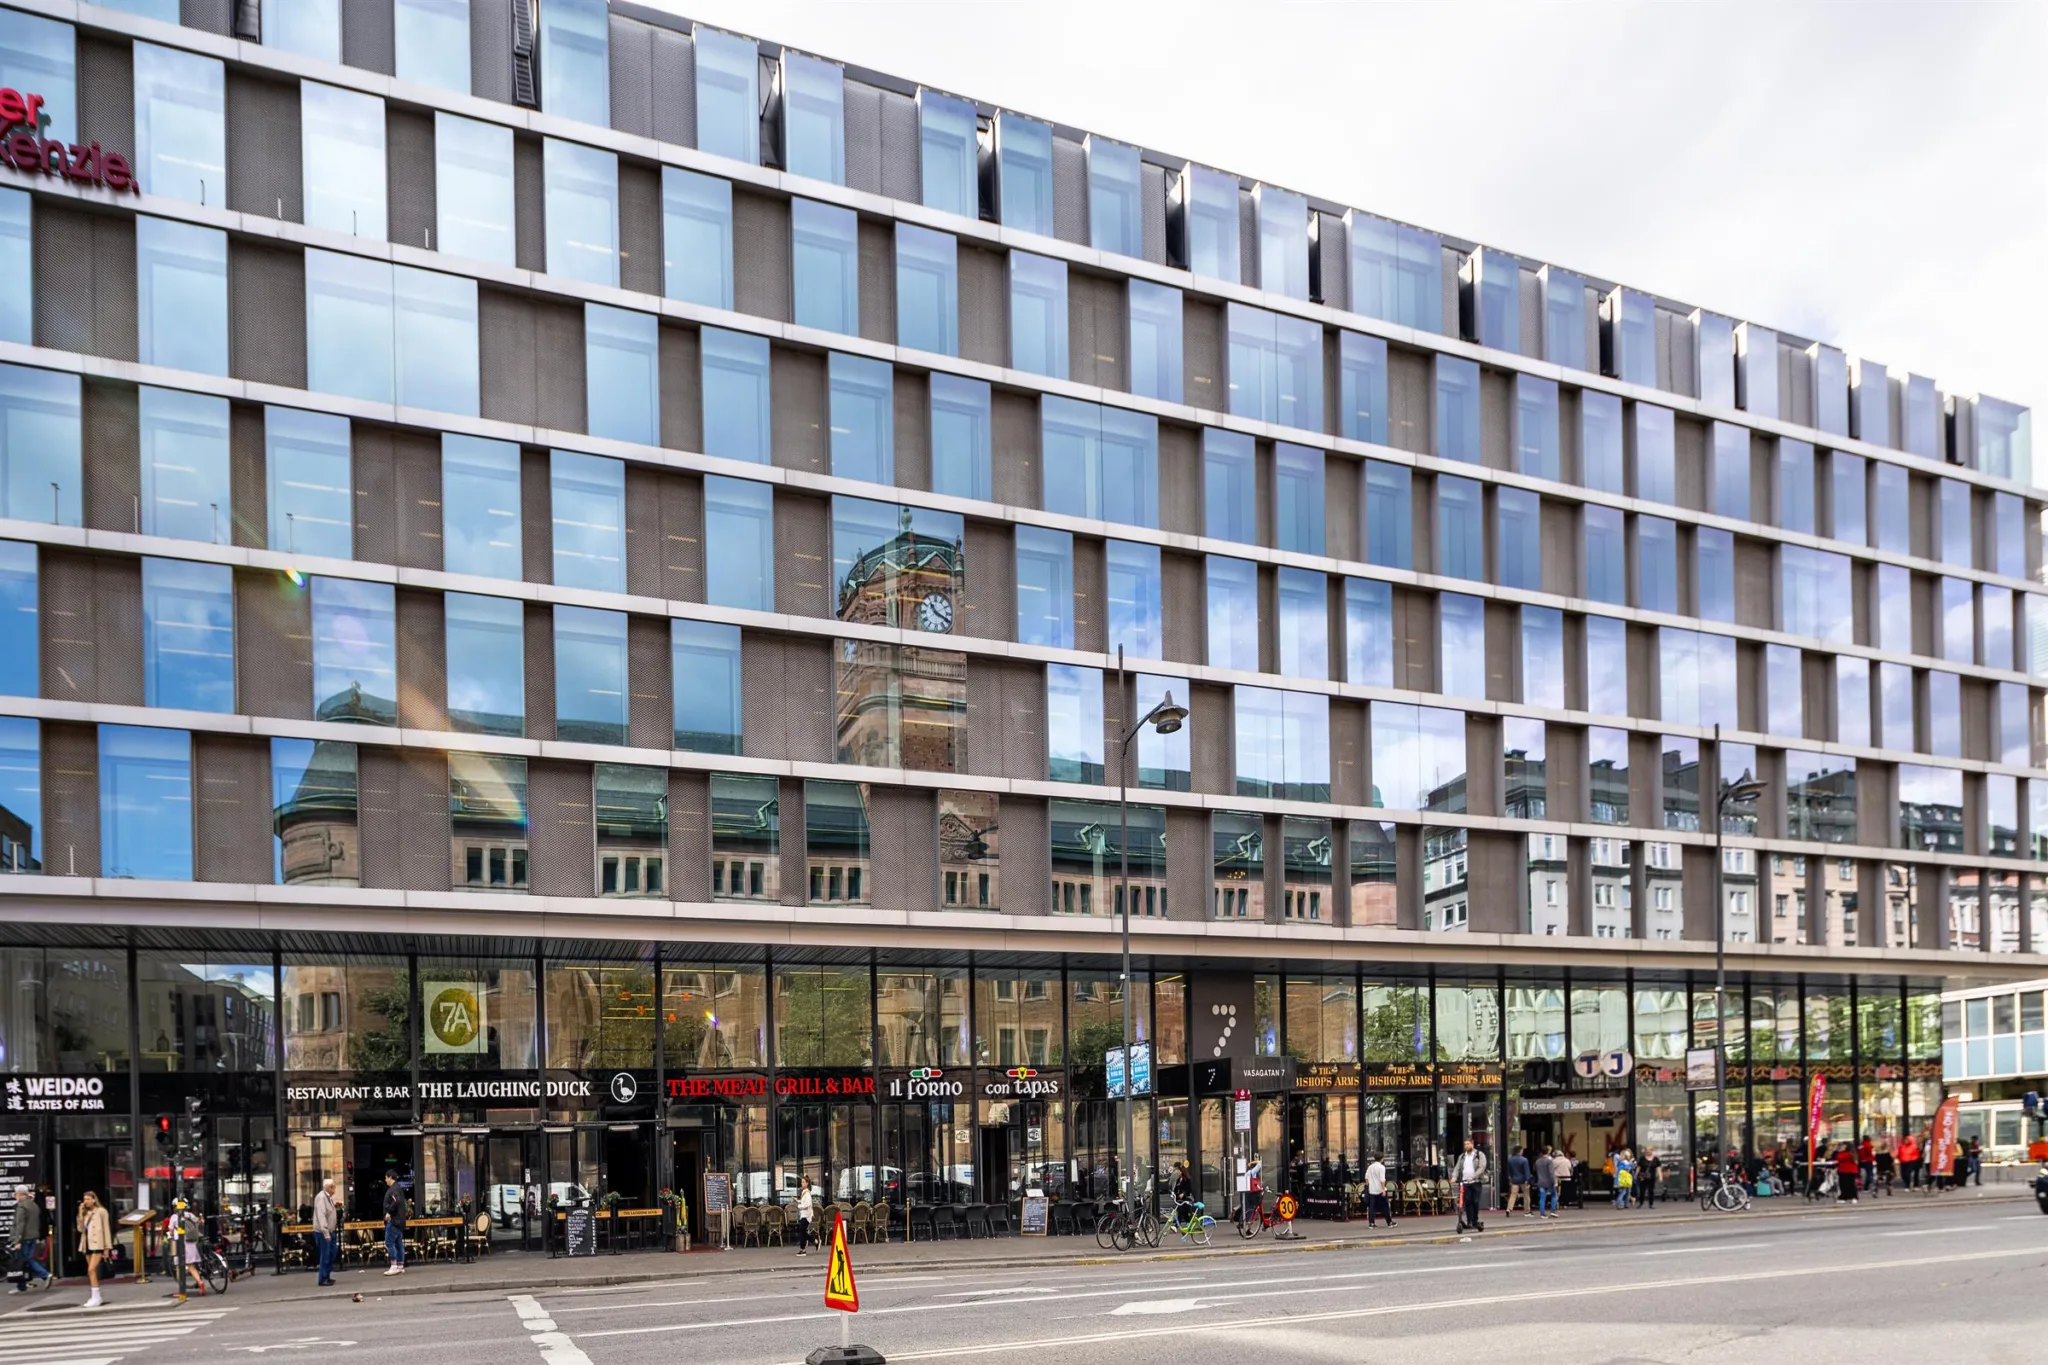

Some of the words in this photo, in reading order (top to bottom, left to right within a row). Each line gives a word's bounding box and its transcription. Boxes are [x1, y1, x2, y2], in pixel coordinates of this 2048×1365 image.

[440, 1002, 472, 1032] 7A
[1580, 1055, 1598, 1075] T
[1609, 1053, 1623, 1075] J
[1243, 1069, 1280, 1077] VASAGATAN
[1335, 1076, 1360, 1086] ARMS
[1368, 1075, 1407, 1086] BISHOPS
[1408, 1075, 1432, 1085] ARMS
[1441, 1075, 1478, 1085] BISHOPS
[1480, 1074, 1502, 1085] ARMS
[24, 1077, 103, 1096] WEIDAO
[418, 1082, 453, 1098] THE
[456, 1081, 541, 1098] LAUGHING
[546, 1081, 590, 1097] DUCK
[666, 1079, 710, 1097] THE
[713, 1078, 768, 1096] MEAT
[774, 1077, 825, 1095] GRILL
[825, 1077, 839, 1094] &
[841, 1077, 875, 1094] BAR
[985, 1083, 1010, 1095] con
[287, 1087, 370, 1100] RESTAURANT
[373, 1086, 383, 1099] &
[385, 1086, 410, 1098] BAR
[26, 1100, 62, 1110] TASTES
[64, 1099, 79, 1110] OF
[81, 1099, 104, 1110] ASIA
[1529, 1101, 1557, 1110] T-Centralen
[1570, 1101, 1595, 1110] Stockholm
[1595, 1100, 1606, 1110] City
[1280, 1201, 1294, 1215] 30
